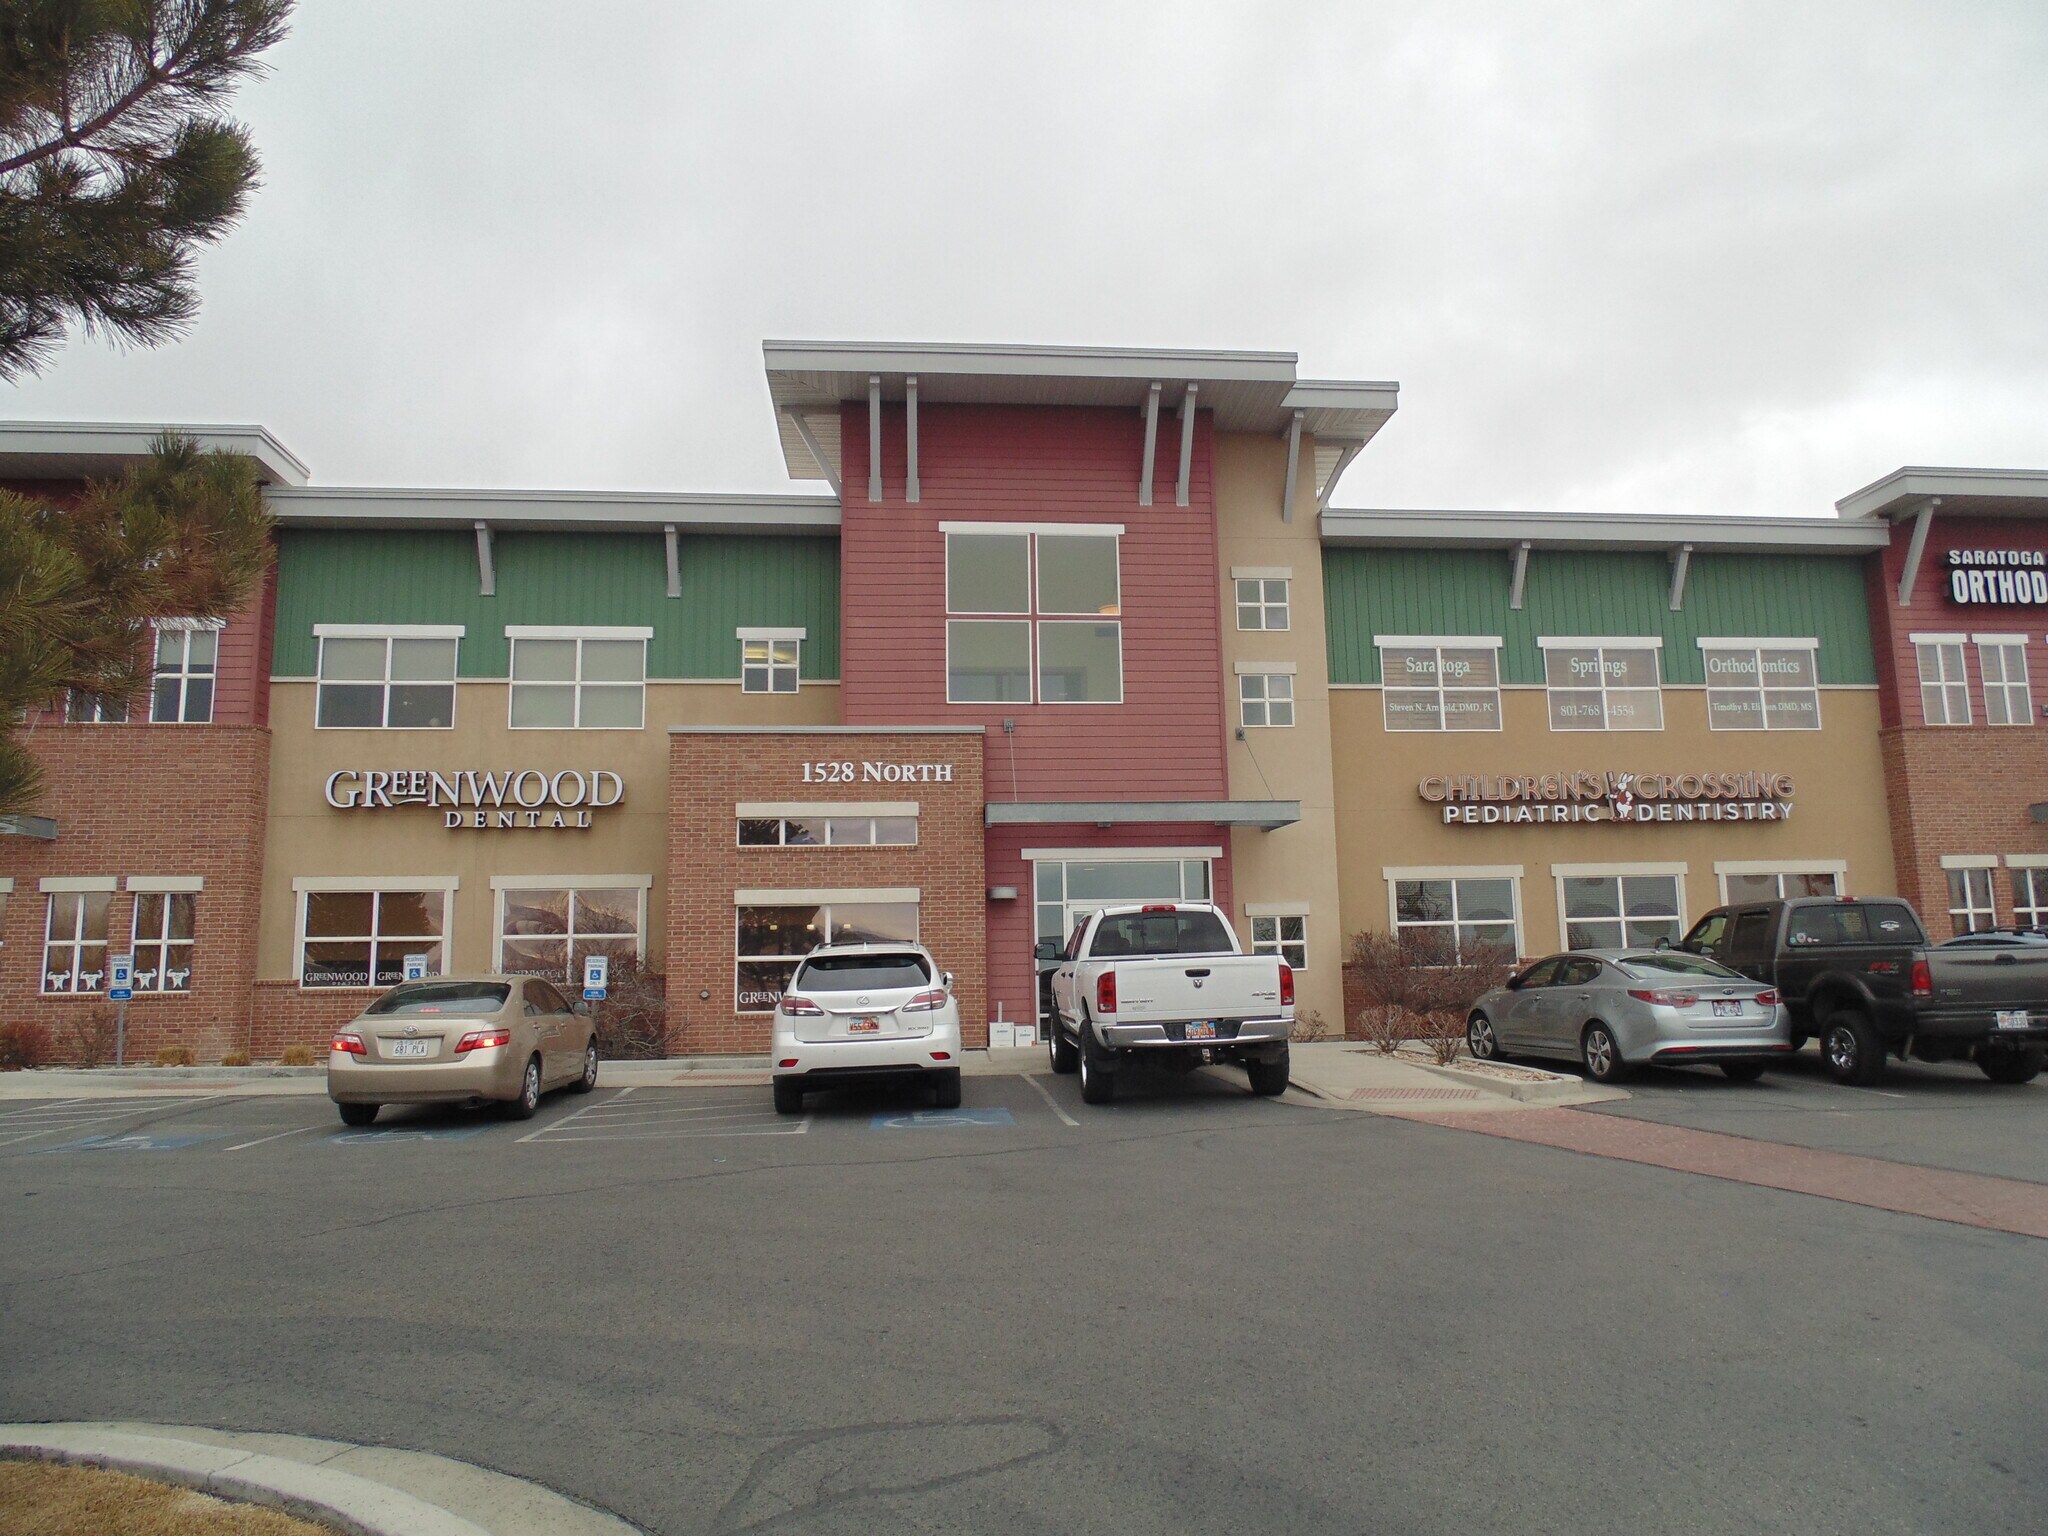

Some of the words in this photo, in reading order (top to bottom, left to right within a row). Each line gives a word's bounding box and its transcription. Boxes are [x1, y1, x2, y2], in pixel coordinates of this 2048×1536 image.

[1949, 550, 2045, 565] SARATOGA
[1952, 570, 2048, 604] ORTHOD
[1406, 656, 1471, 677] Saratoga
[1570, 657, 1628, 678] Springs
[1709, 657, 1800, 674] Orthodontics
[1389, 703, 1414, 712] Steven
[1415, 703, 1424, 712] N.
[1484, 703, 1494, 712] PC
[1712, 702, 1742, 713] Timothy
[801, 762, 855, 783] 1528
[861, 761, 953, 782] NORTH
[325, 769, 625, 808] GREENWOOD
[1633, 771, 1797, 800] CROSSING
[444, 810, 592, 828] DENTAL
[1443, 803, 1600, 824] PEDIATRIC
[1634, 802, 1794, 822] DENTISTRY
[305, 971, 368, 982] GREENWOOD
